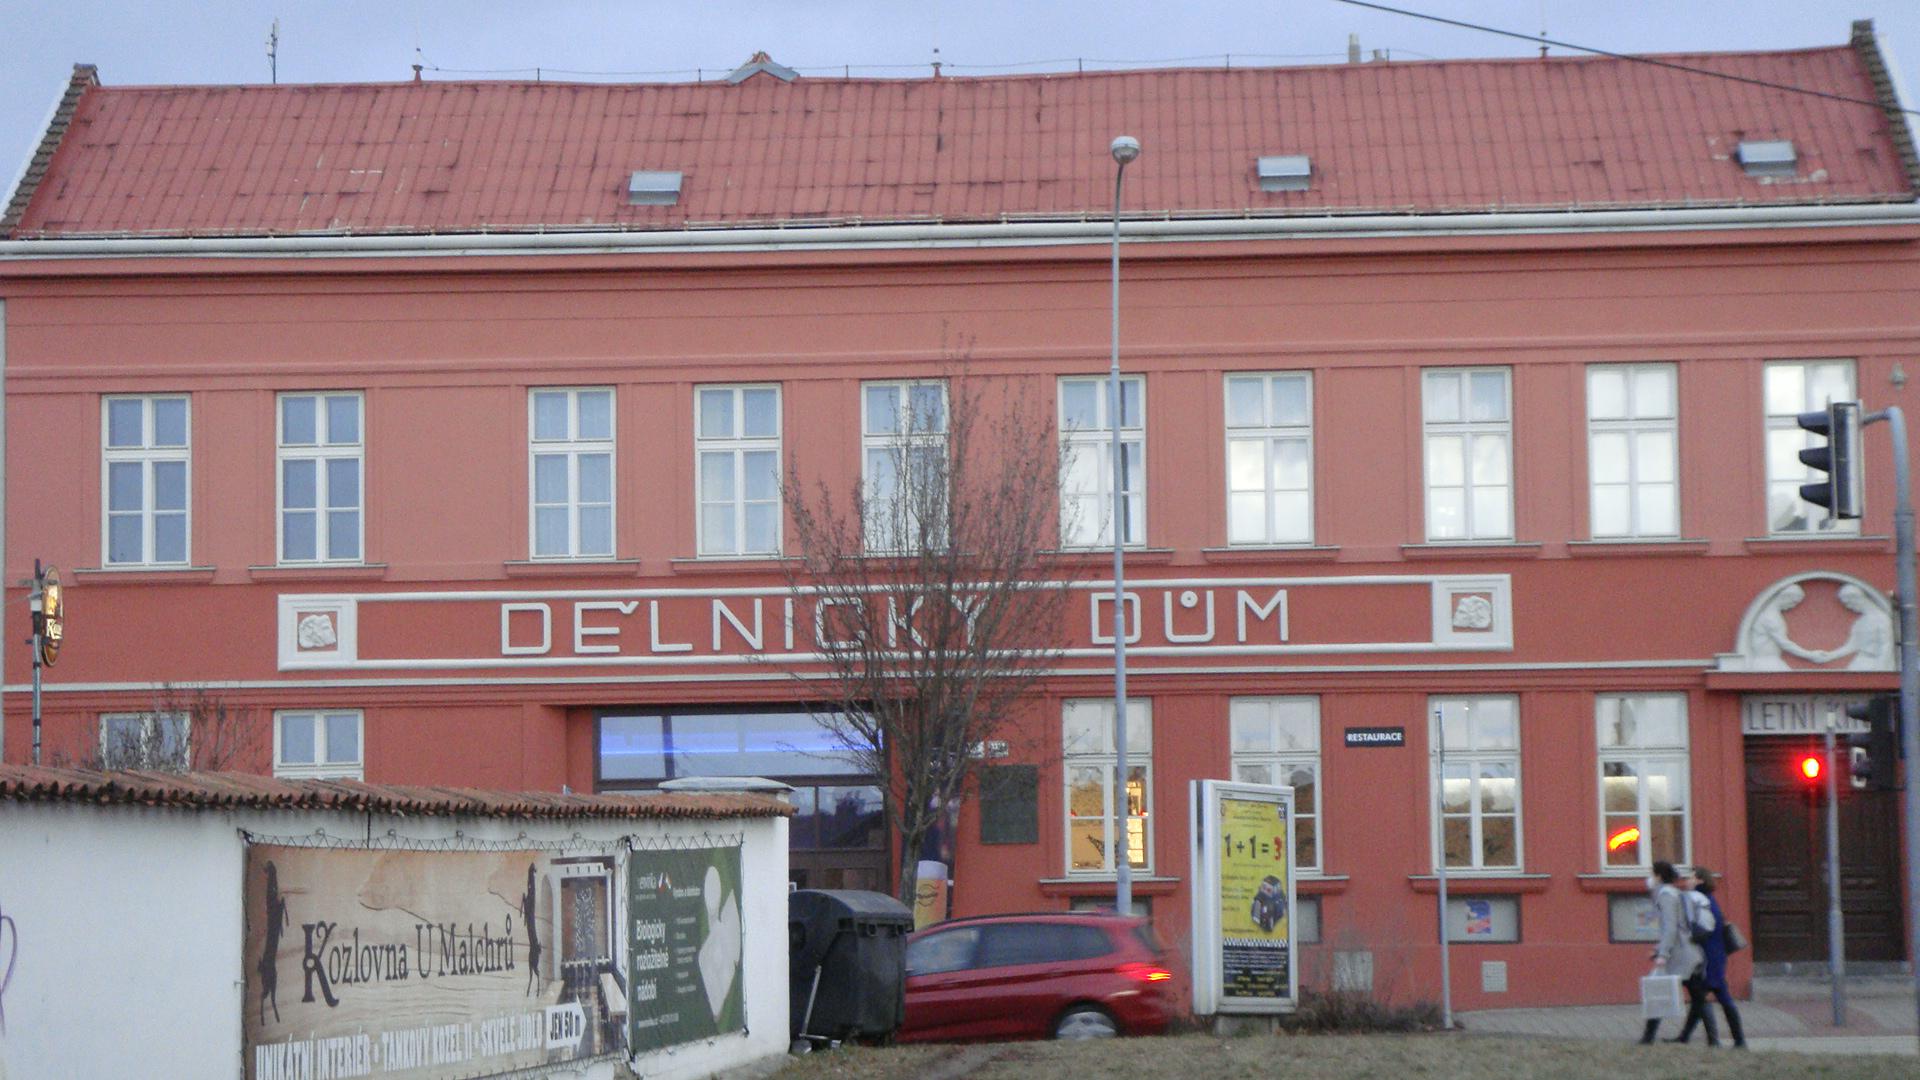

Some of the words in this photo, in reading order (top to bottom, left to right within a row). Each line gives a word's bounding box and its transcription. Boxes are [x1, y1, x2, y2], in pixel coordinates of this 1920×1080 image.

[1091, 590, 1289, 644] DŮM
[1346, 732, 1403, 742] RESTAURACE
[1274, 836, 1282, 861] 3
[637, 919, 666, 945] Biologicky
[302, 921, 409, 1007] Kozlovna
[415, 924, 433, 978] U
[438, 913, 515, 977] Malchrů
[550, 1012, 563, 1041] JEN
[565, 1011, 573, 1039] 50
[256, 1033, 315, 1080] UNIKÁTNÍ
[317, 1026, 371, 1080] INTERIÉR
[432, 1023, 462, 1066] KOZEL
